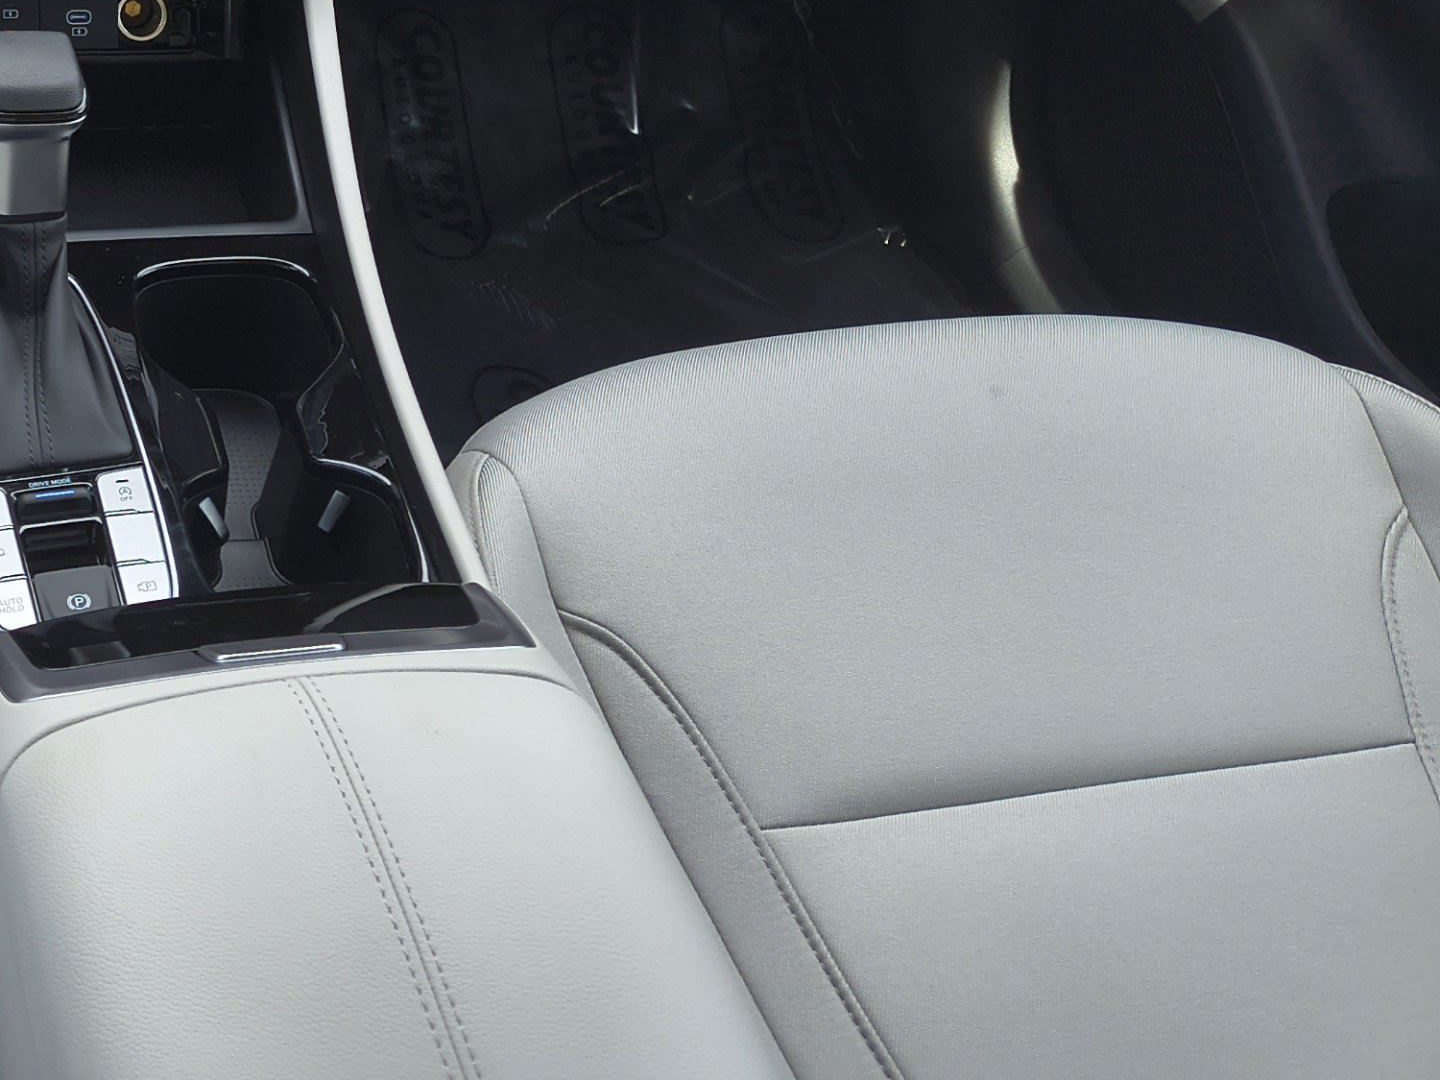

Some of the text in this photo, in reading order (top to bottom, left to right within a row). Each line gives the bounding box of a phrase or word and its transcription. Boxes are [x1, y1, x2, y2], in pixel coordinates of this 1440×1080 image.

[28, 477, 71, 488] DRIVE MODE
[0, 605, 25, 615] HOLD
